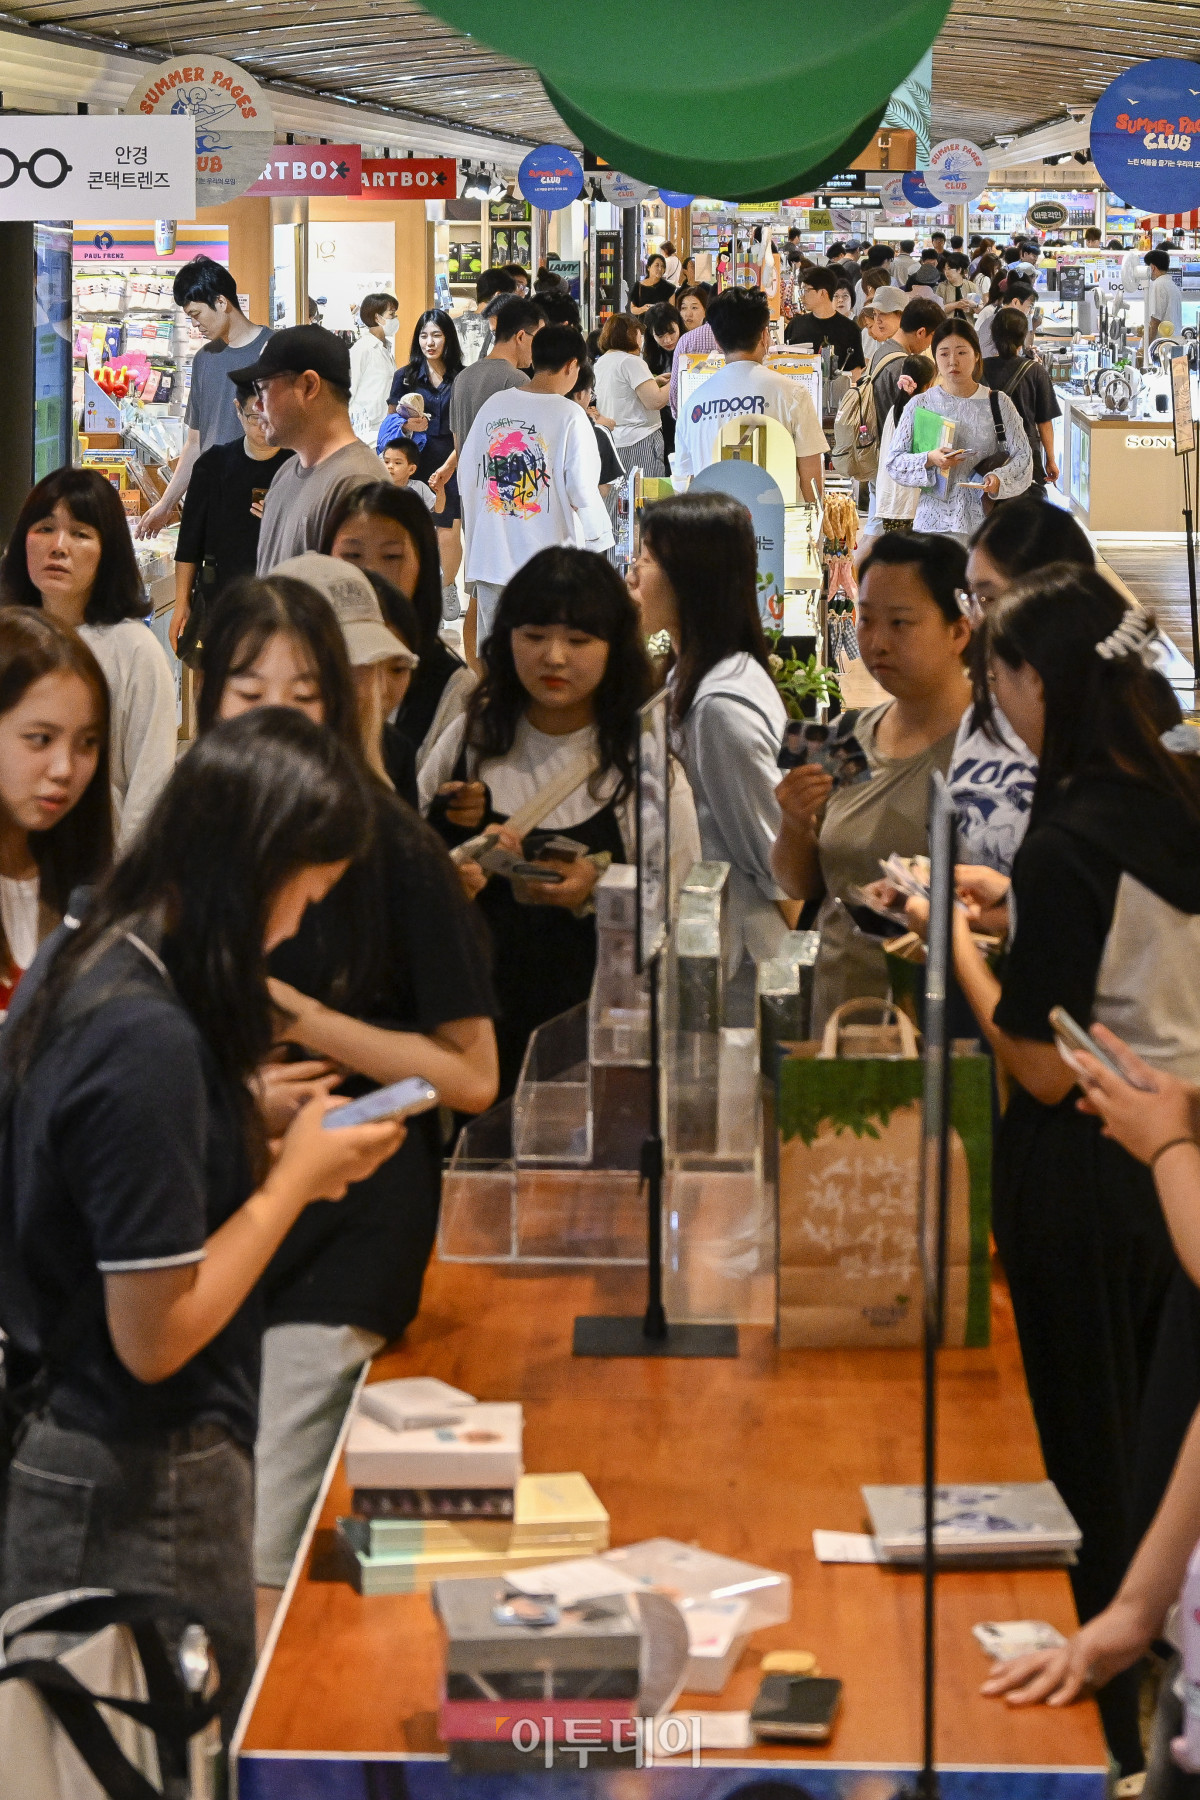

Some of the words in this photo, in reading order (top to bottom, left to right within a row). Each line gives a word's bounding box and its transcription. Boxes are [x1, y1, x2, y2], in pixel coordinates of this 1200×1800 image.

[140, 66, 205, 115] SUMMER
[211, 70, 257, 119] PAGES
[1115, 113, 1175, 136] SUMMER
[1178, 116, 1200, 134] PAG
[1143, 132, 1192, 151] CLUB
[114, 144, 149, 165] 안경
[196, 155, 223, 173] UB
[931, 143, 960, 165] SUMMER
[962, 145, 983, 167] PAGES
[86, 170, 171, 190] 콘택트렌즈
[257, 160, 350, 180] RTBOX
[944, 181, 968, 190] CLUB
[549, 263, 579, 271] LAMY
